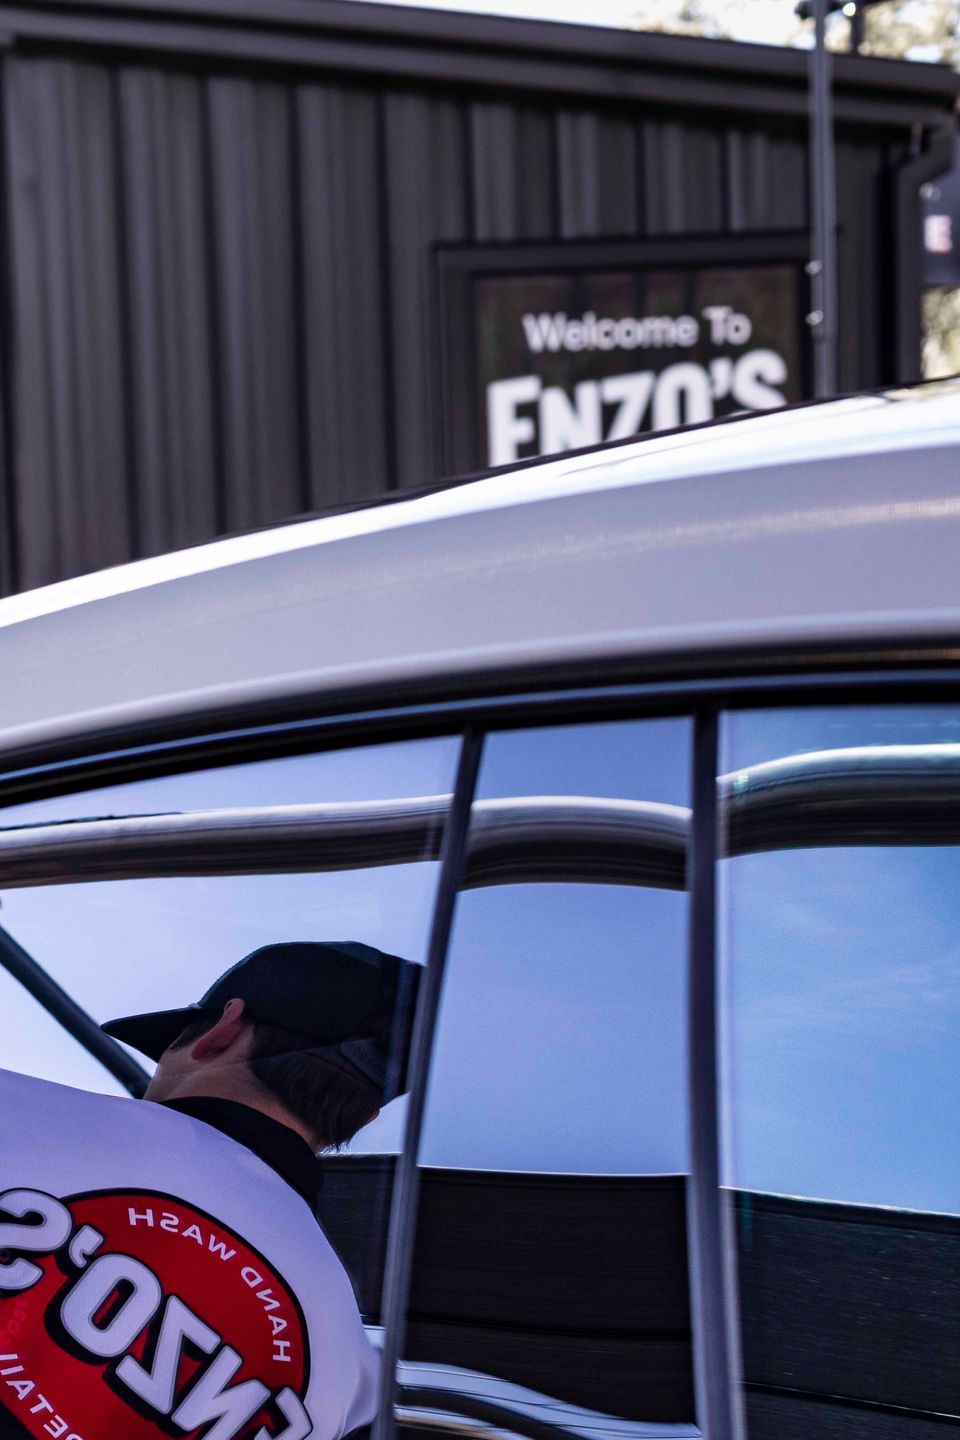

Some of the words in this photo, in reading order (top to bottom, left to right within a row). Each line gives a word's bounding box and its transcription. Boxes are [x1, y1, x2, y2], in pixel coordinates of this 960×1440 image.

[522, 311, 700, 353] Welcome
[703, 305, 752, 346] To
[487, 347, 788, 469] ENZO'S
